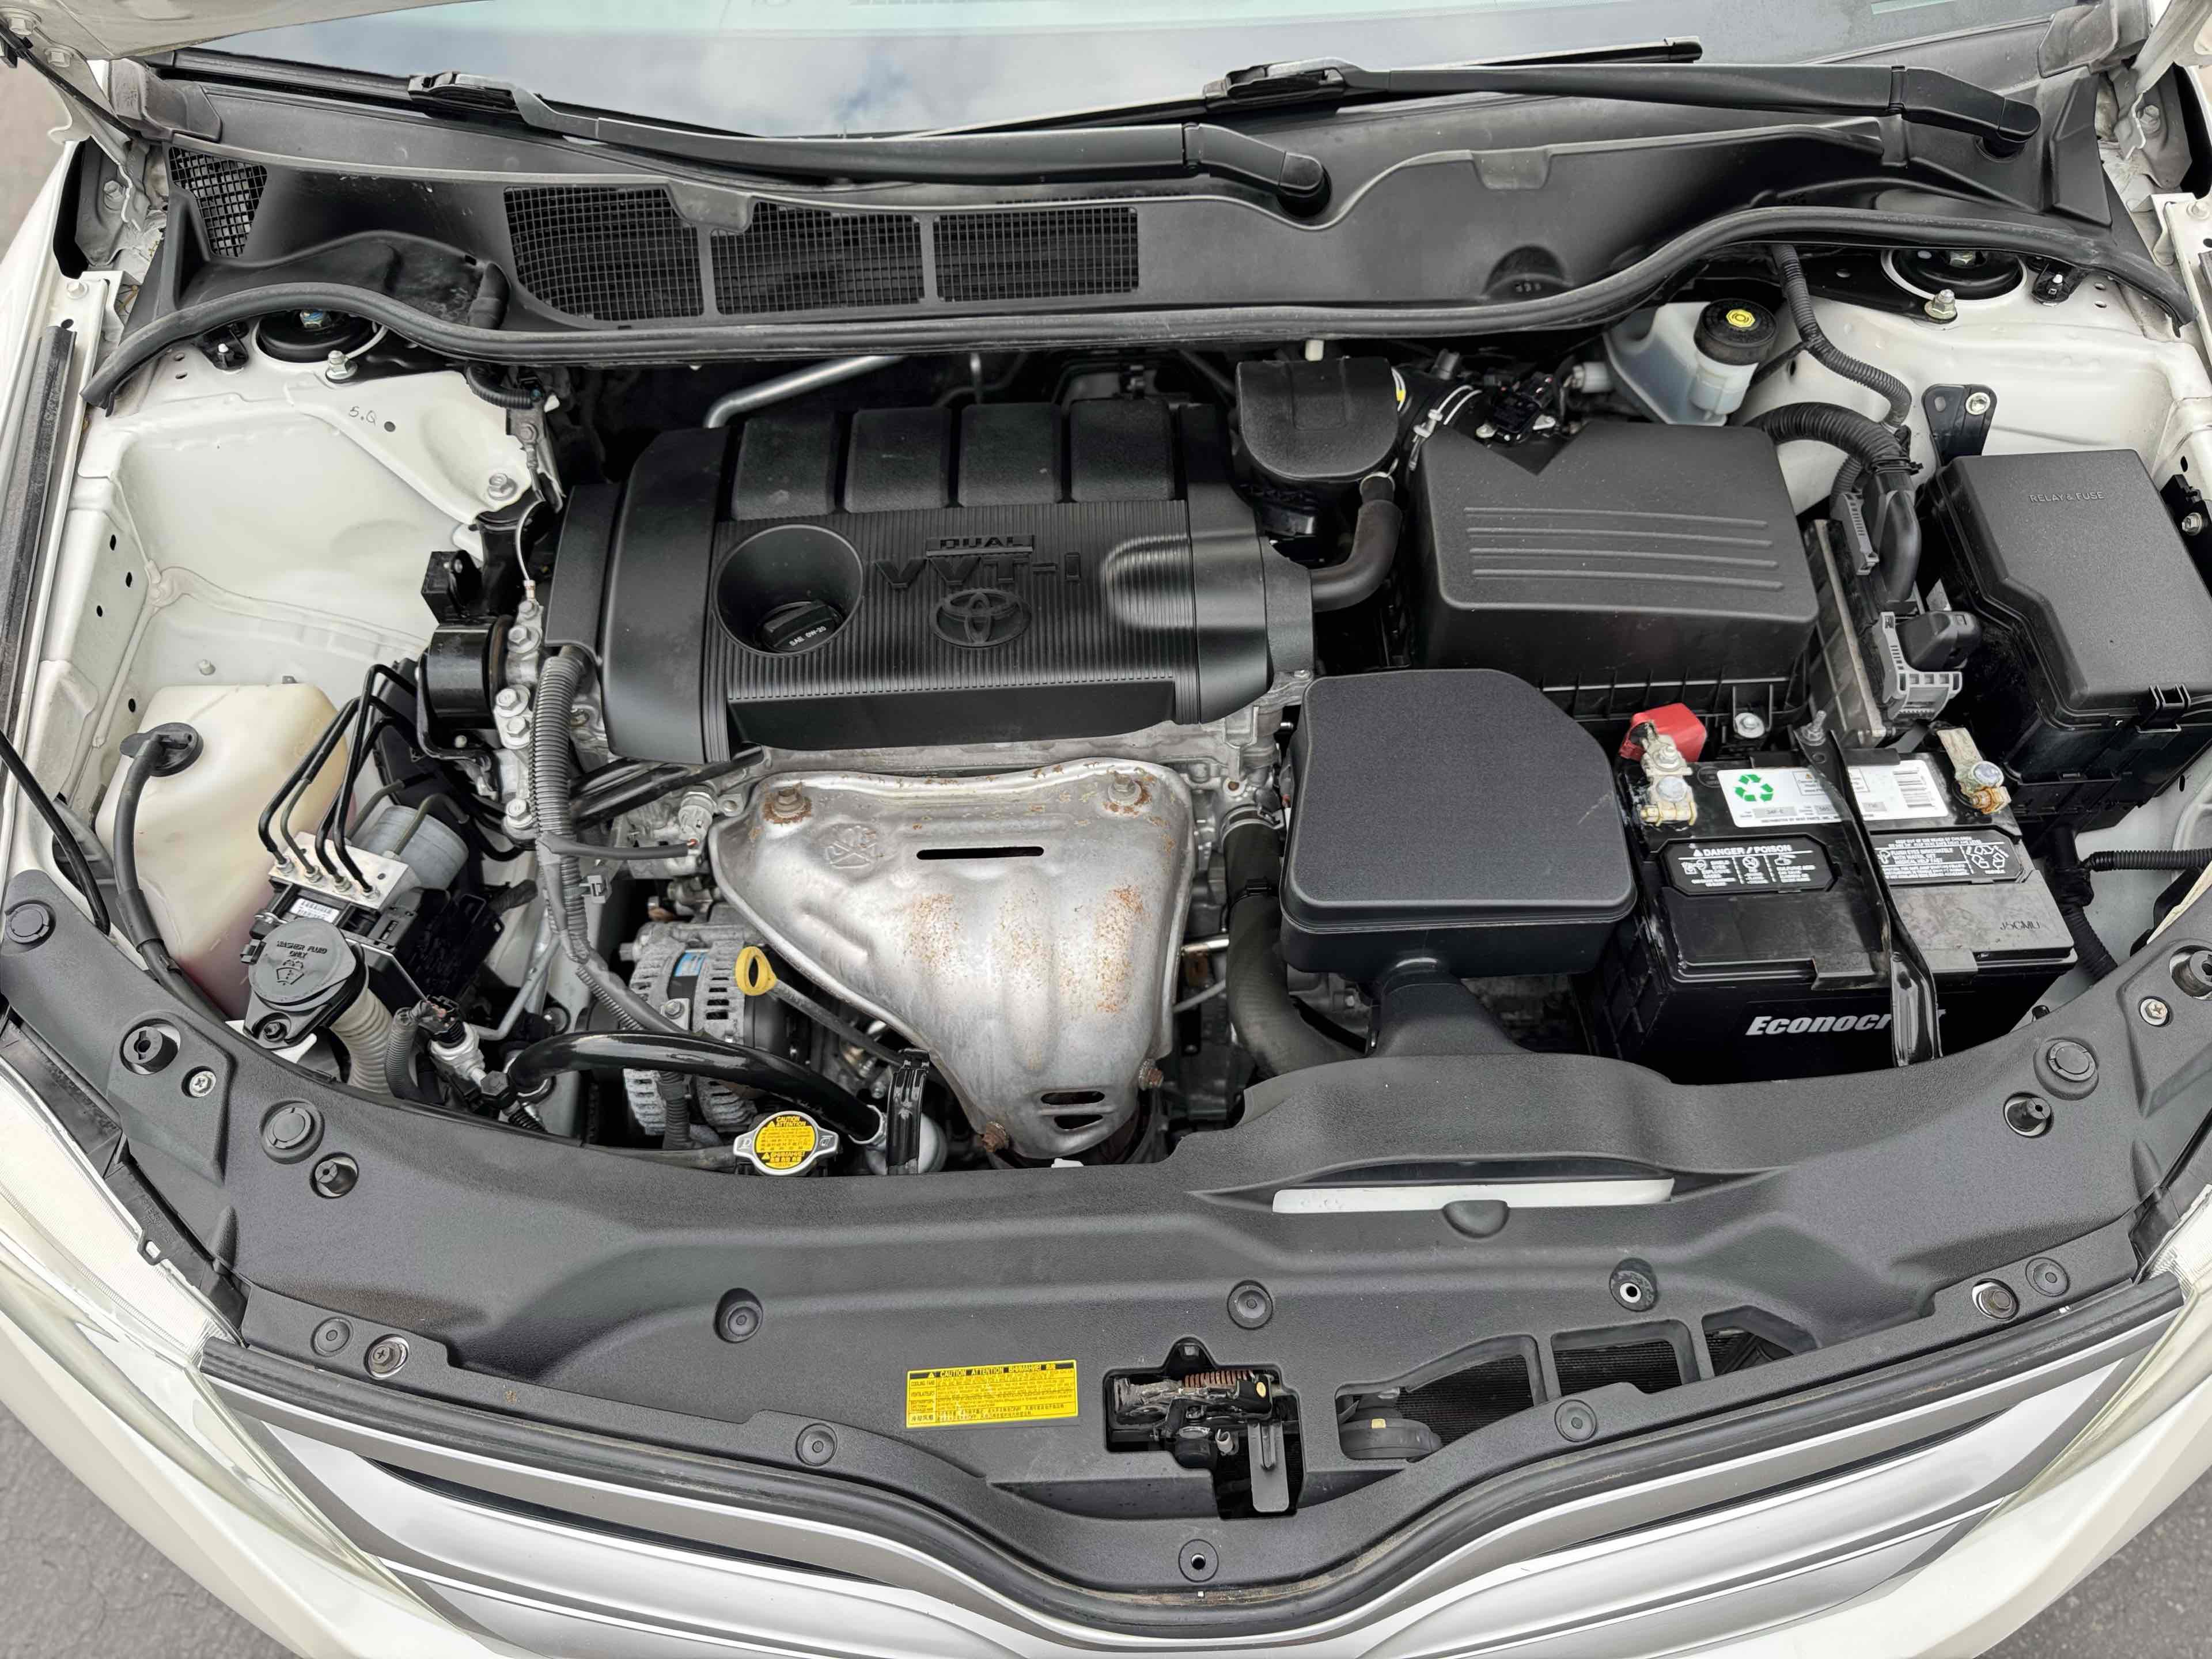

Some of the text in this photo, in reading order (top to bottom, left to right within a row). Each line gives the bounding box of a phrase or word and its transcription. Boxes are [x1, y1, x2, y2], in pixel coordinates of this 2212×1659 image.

[2029, 491, 2105, 503] RELAY & FUSE
[940, 536, 1024, 550] DUAL
[1703, 844, 1793, 857] DANGER / POISON
[276, 940, 328, 955] WASHER FLUID
[289, 950, 308, 959] ONLY
[940, 1366, 1004, 1377] CAUTION ATTENTION
